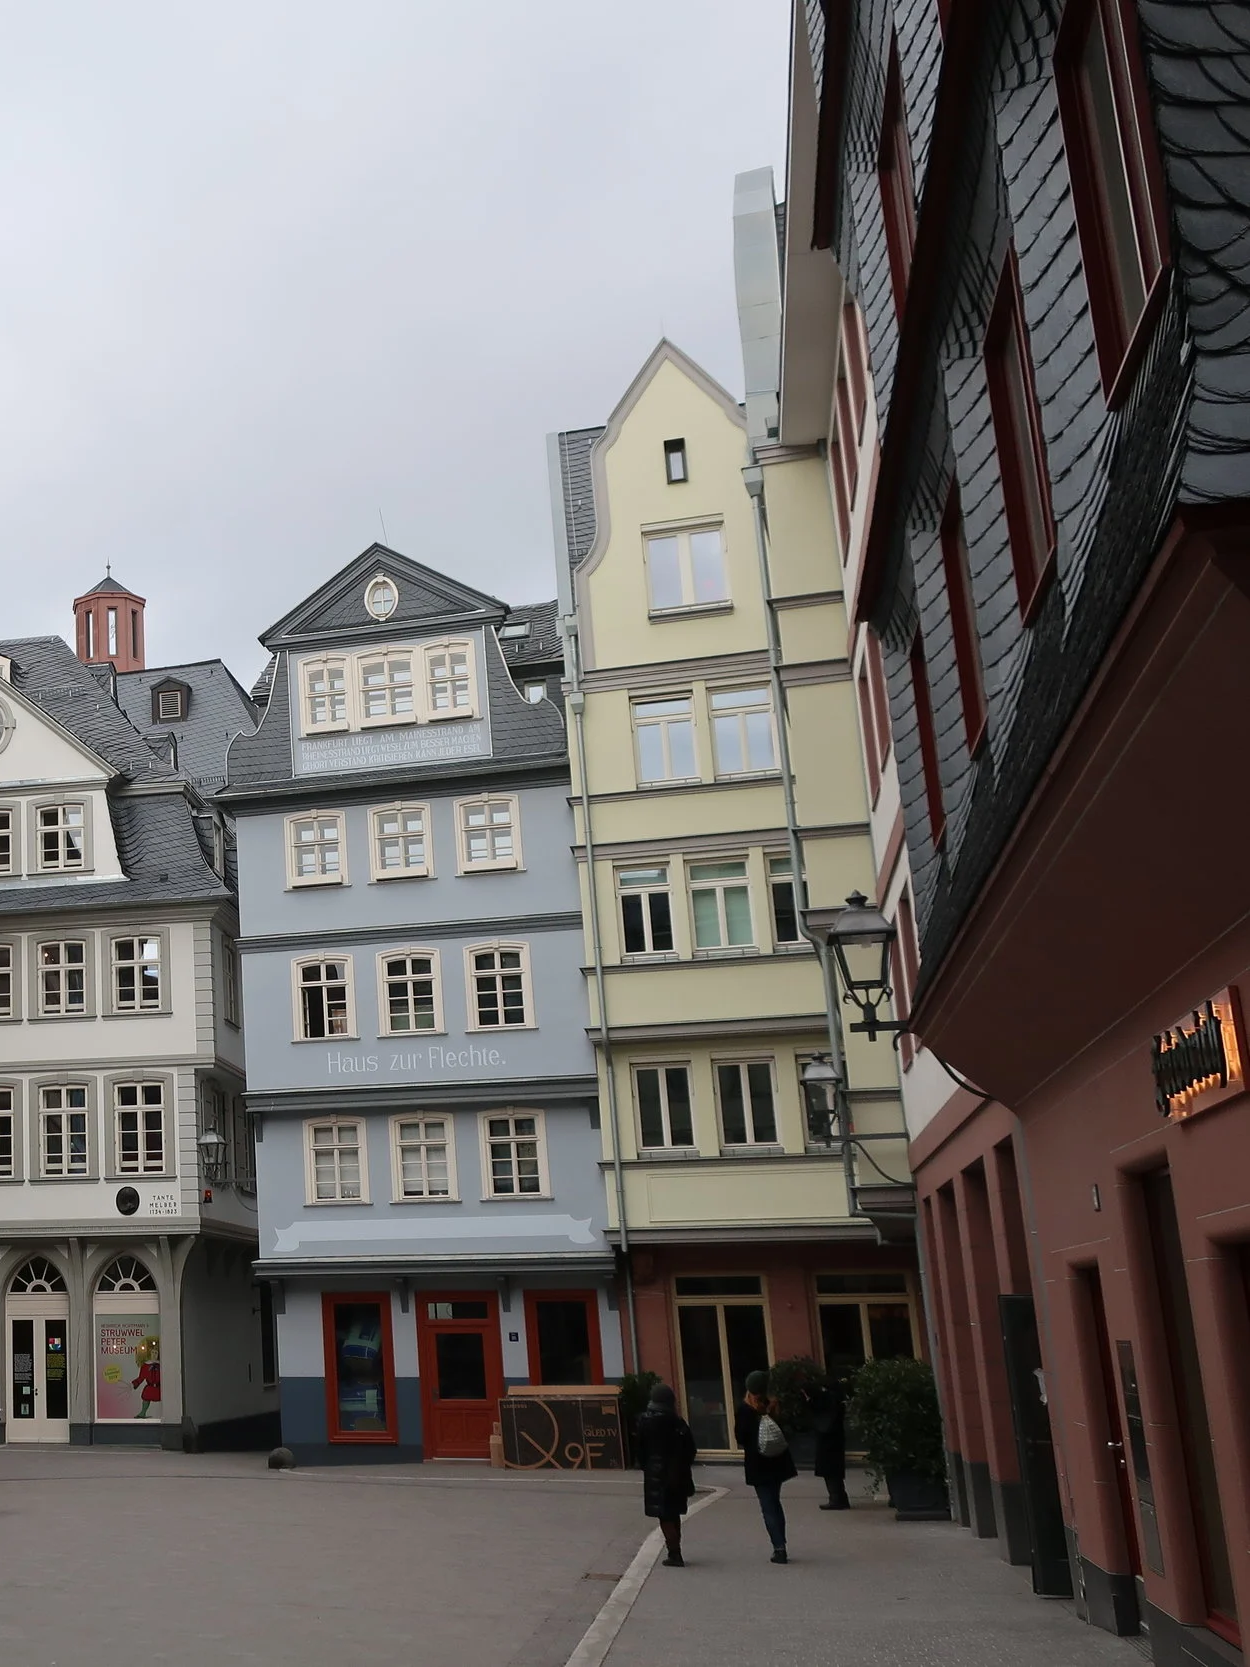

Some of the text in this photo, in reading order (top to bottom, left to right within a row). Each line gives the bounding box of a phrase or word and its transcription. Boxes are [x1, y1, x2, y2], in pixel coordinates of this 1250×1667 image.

[301, 724, 481, 751] FRANKFURT LIEGT AM MAINESSTRAND AM
[302, 733, 482, 760] RHEINESSTRAND LIEGT WESEL ZUM BESSER MACHEN
[328, 756, 366, 768] VERSTAND
[415, 748, 437, 759] KANN
[437, 746, 462, 757] JEDER
[463, 743, 482, 754] ESEL
[327, 1044, 507, 1074] Haus zur Flechte.
[101, 1328, 145, 1337] STRUWWEL
[101, 1338, 127, 1346] PETER
[101, 1346, 138, 1355] MUSEUM
[607, 1428, 618, 1437] TV
